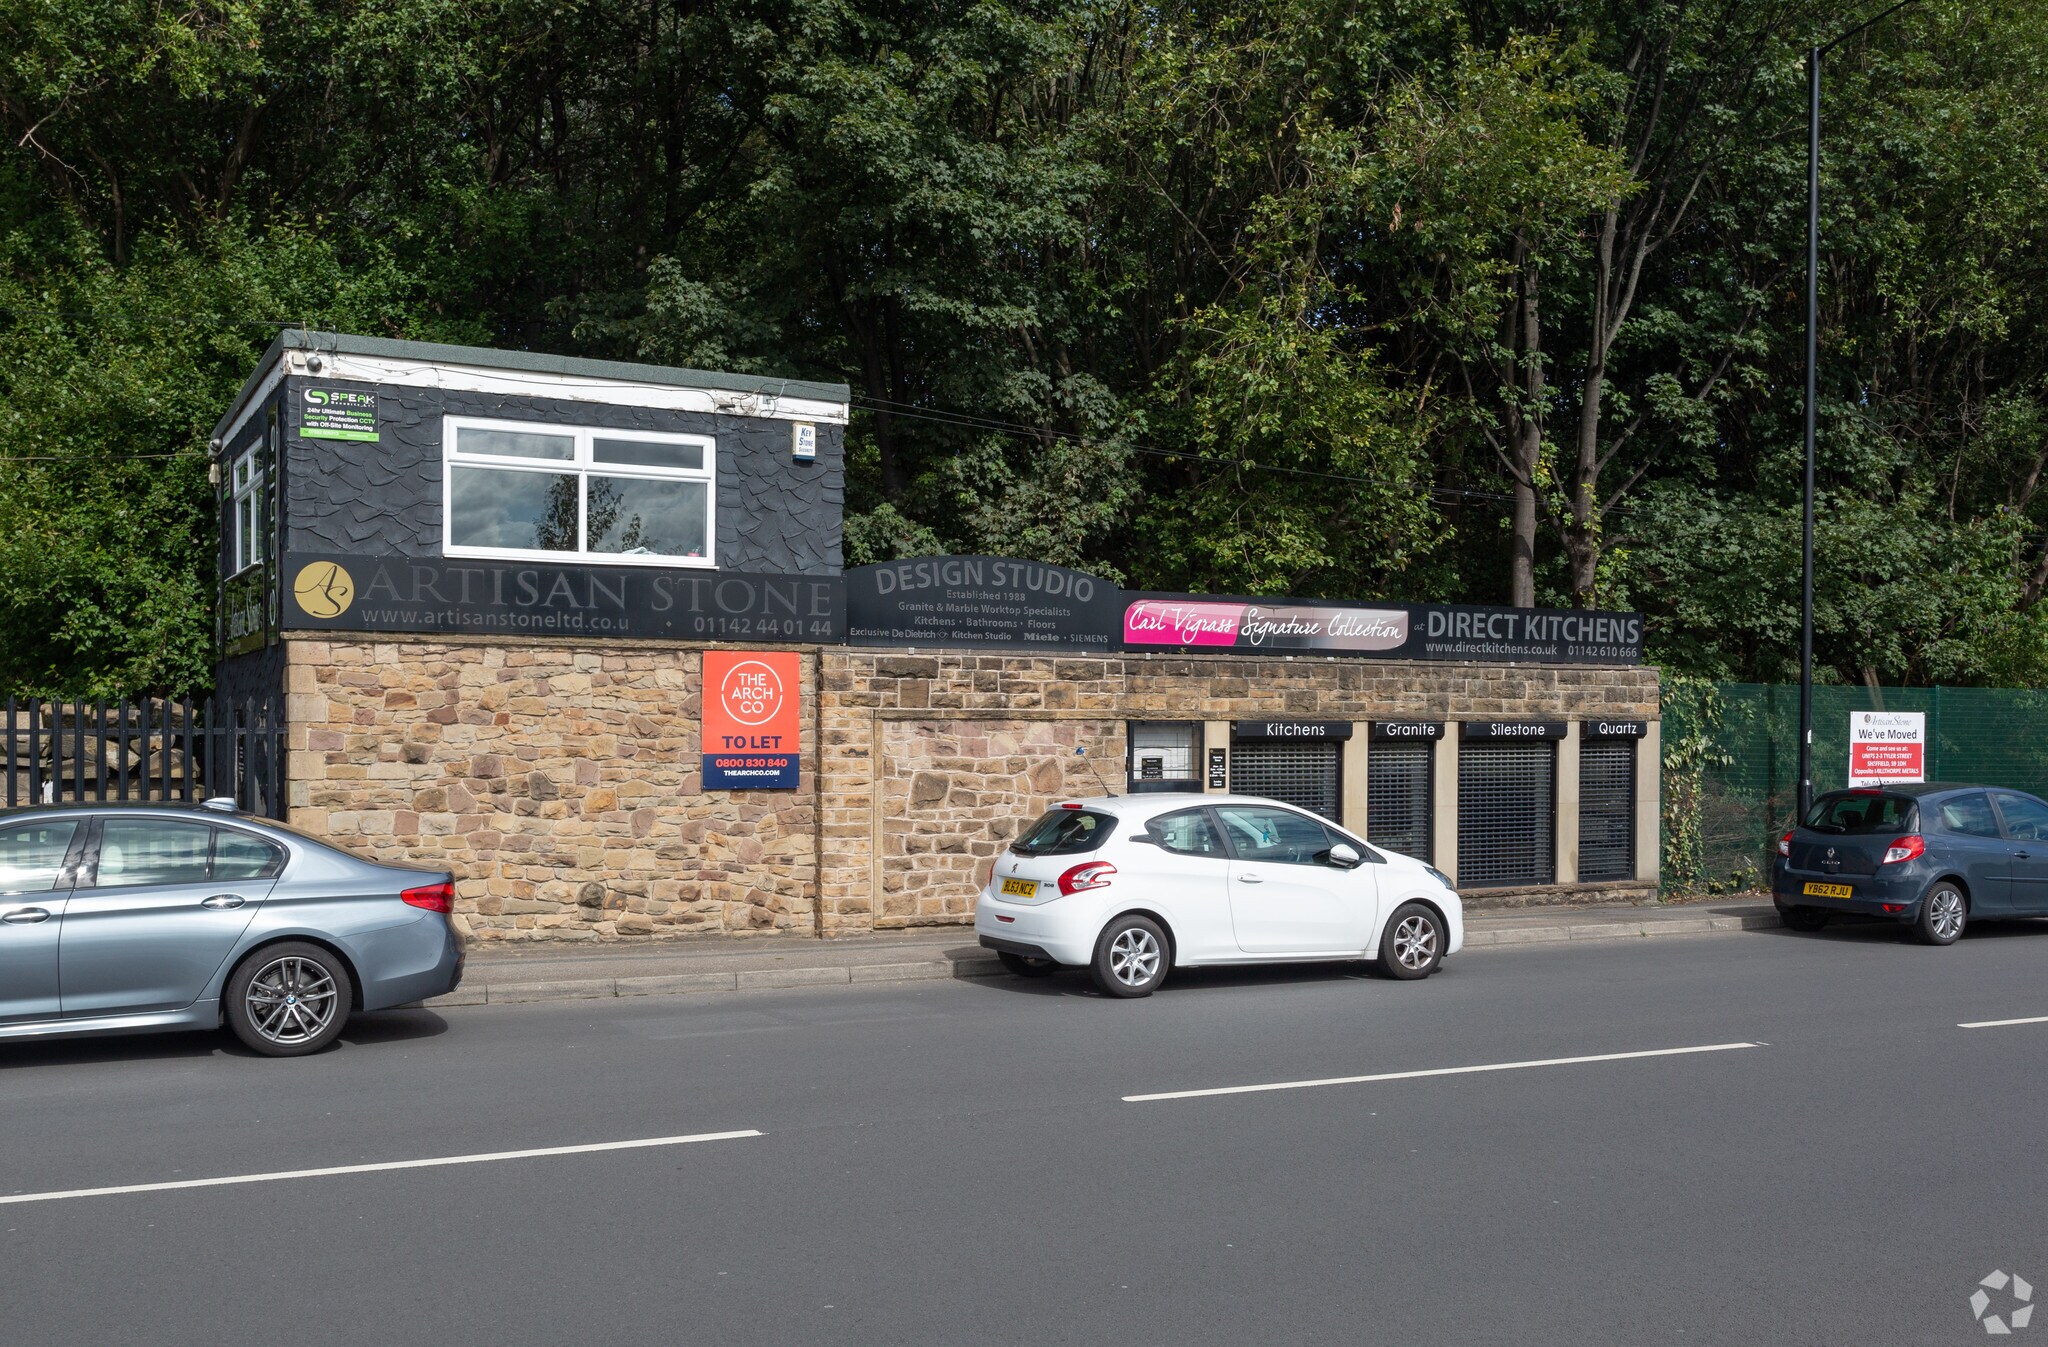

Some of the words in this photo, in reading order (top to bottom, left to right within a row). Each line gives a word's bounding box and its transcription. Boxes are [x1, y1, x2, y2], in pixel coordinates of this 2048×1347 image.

[331, 392, 375, 404] SPEAK
[304, 414, 328, 422] Security
[321, 408, 345, 416] Ultimate
[346, 410, 372, 418] Business
[342, 423, 373, 432] Monitoring
[875, 560, 983, 594] DESIGN
[992, 562, 1094, 602] STUDIO
[359, 563, 629, 609] ARTISAN
[651, 576, 832, 617] STONE
[947, 589, 1000, 600] Established
[1003, 592, 1026, 601] 1988
[898, 602, 934, 611] Granite
[936, 602, 943, 611] &
[946, 603, 979, 613] Marble
[981, 604, 1021, 616] Worktop
[1023, 606, 1071, 617] Specialists
[694, 616, 751, 633] 01142
[756, 619, 778, 634] 44
[783, 620, 803, 635] 01
[810, 620, 831, 635] 44
[914, 616, 956, 626] Kitchens
[966, 618, 1018, 627] Bathrooms
[1028, 620, 1056, 629] Floors
[1129, 608, 1166, 631] Carl
[1171, 607, 1235, 644] Vigrass
[1241, 607, 1322, 645] Signature
[1327, 611, 1403, 639] Collection
[1414, 621, 1426, 631] at
[1428, 611, 1519, 639] DIRECT
[1524, 615, 1640, 644] KITCHENS
[850, 628, 890, 637] Exclusive
[891, 628, 904, 638] De
[904, 629, 936, 639] Dietrich
[951, 631, 983, 639] Kitchen
[984, 631, 1012, 640] Studio
[1023, 632, 1060, 641] Miele
[1070, 633, 1108, 643] SIEMENS
[1425, 641, 1558, 656] www.directkitchens.co.uk
[1567, 645, 1598, 656] 01142
[1600, 646, 1618, 657] 610
[1619, 647, 1637, 658] 666
[738, 673, 767, 686] THE
[731, 686, 774, 700] ARCH
[740, 701, 764, 714] CO
[1266, 723, 1325, 736] Kitchens
[1386, 723, 1436, 736] Granite
[1490, 723, 1545, 736] Silestone
[1598, 722, 1637, 735] Quartz
[1859, 729, 1886, 739] We've
[1887, 729, 1917, 740] Moved
[721, 735, 747, 749] TO
[750, 736, 782, 749] LET
[715, 758, 744, 767] 0800
[745, 758, 766, 767] 830
[767, 758, 788, 767] 840
[1019, 882, 1035, 895] NCZ
[1808, 884, 1829, 895] YB62
[1830, 886, 1849, 896] RJU
